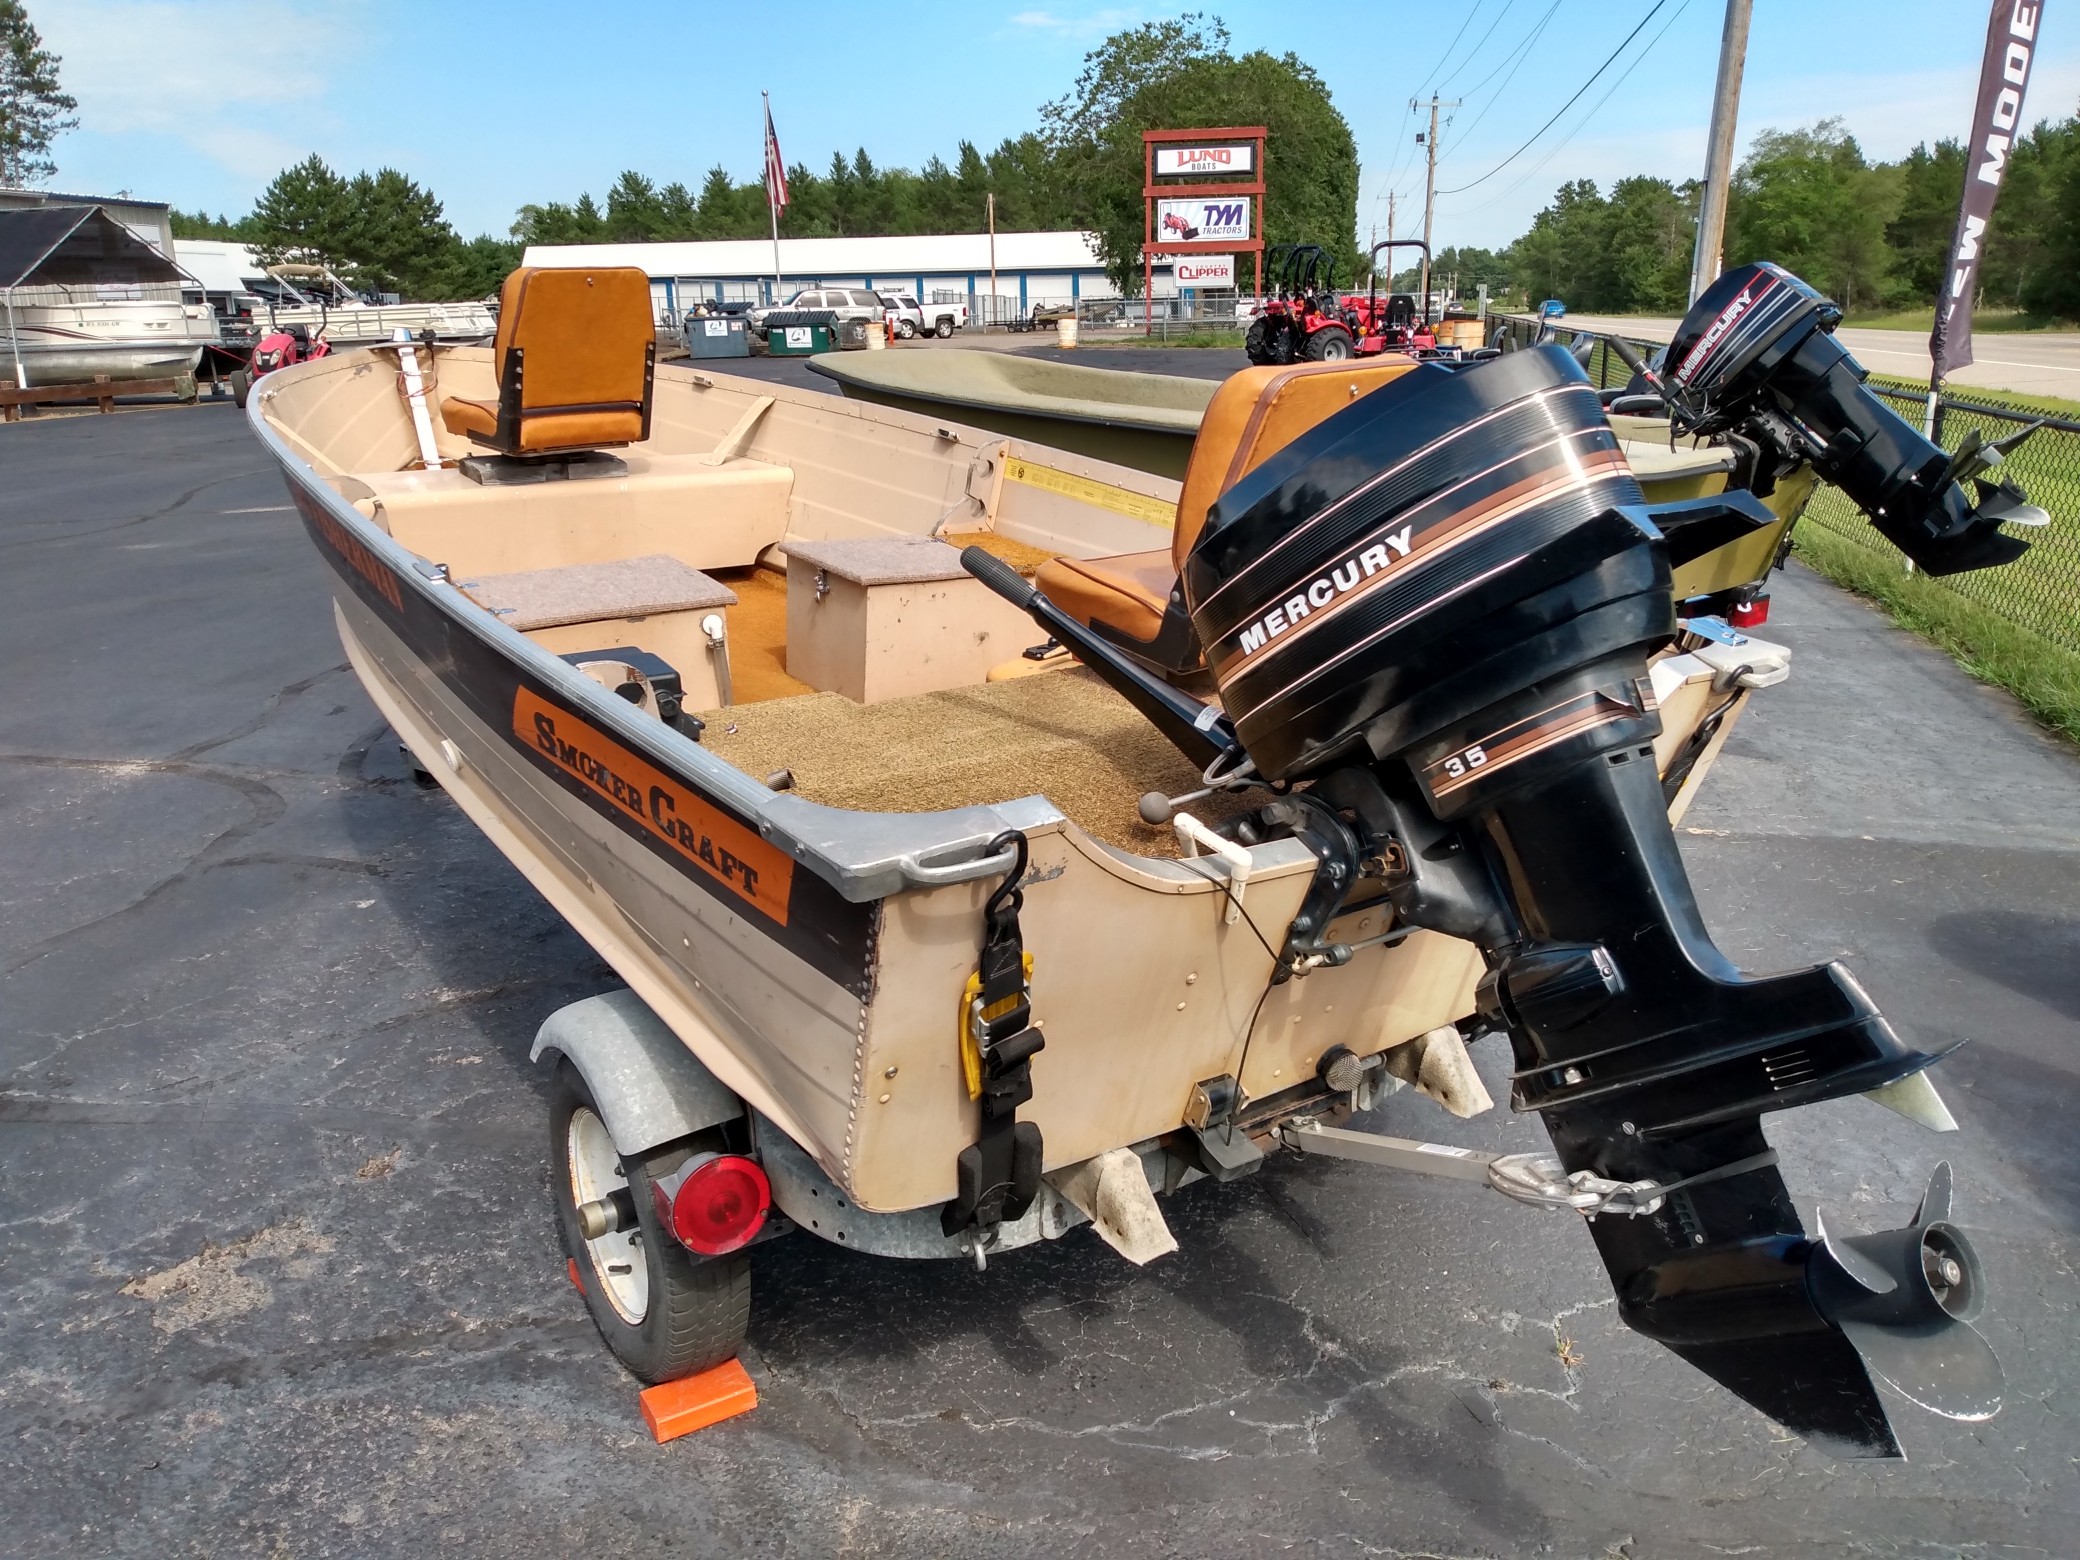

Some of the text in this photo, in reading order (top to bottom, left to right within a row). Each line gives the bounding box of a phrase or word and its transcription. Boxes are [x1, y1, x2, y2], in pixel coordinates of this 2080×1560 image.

[1177, 149, 1231, 167] LUND
[1948, 0, 2039, 321] EW MODE
[1203, 204, 1244, 226] TYM
[1202, 226, 1242, 235] TRACTORS
[1178, 265, 1229, 280] CLIPPER
[1678, 288, 1752, 381] MERCURY
[1239, 524, 1413, 656] MERCURY
[1444, 745, 1488, 778] 35
